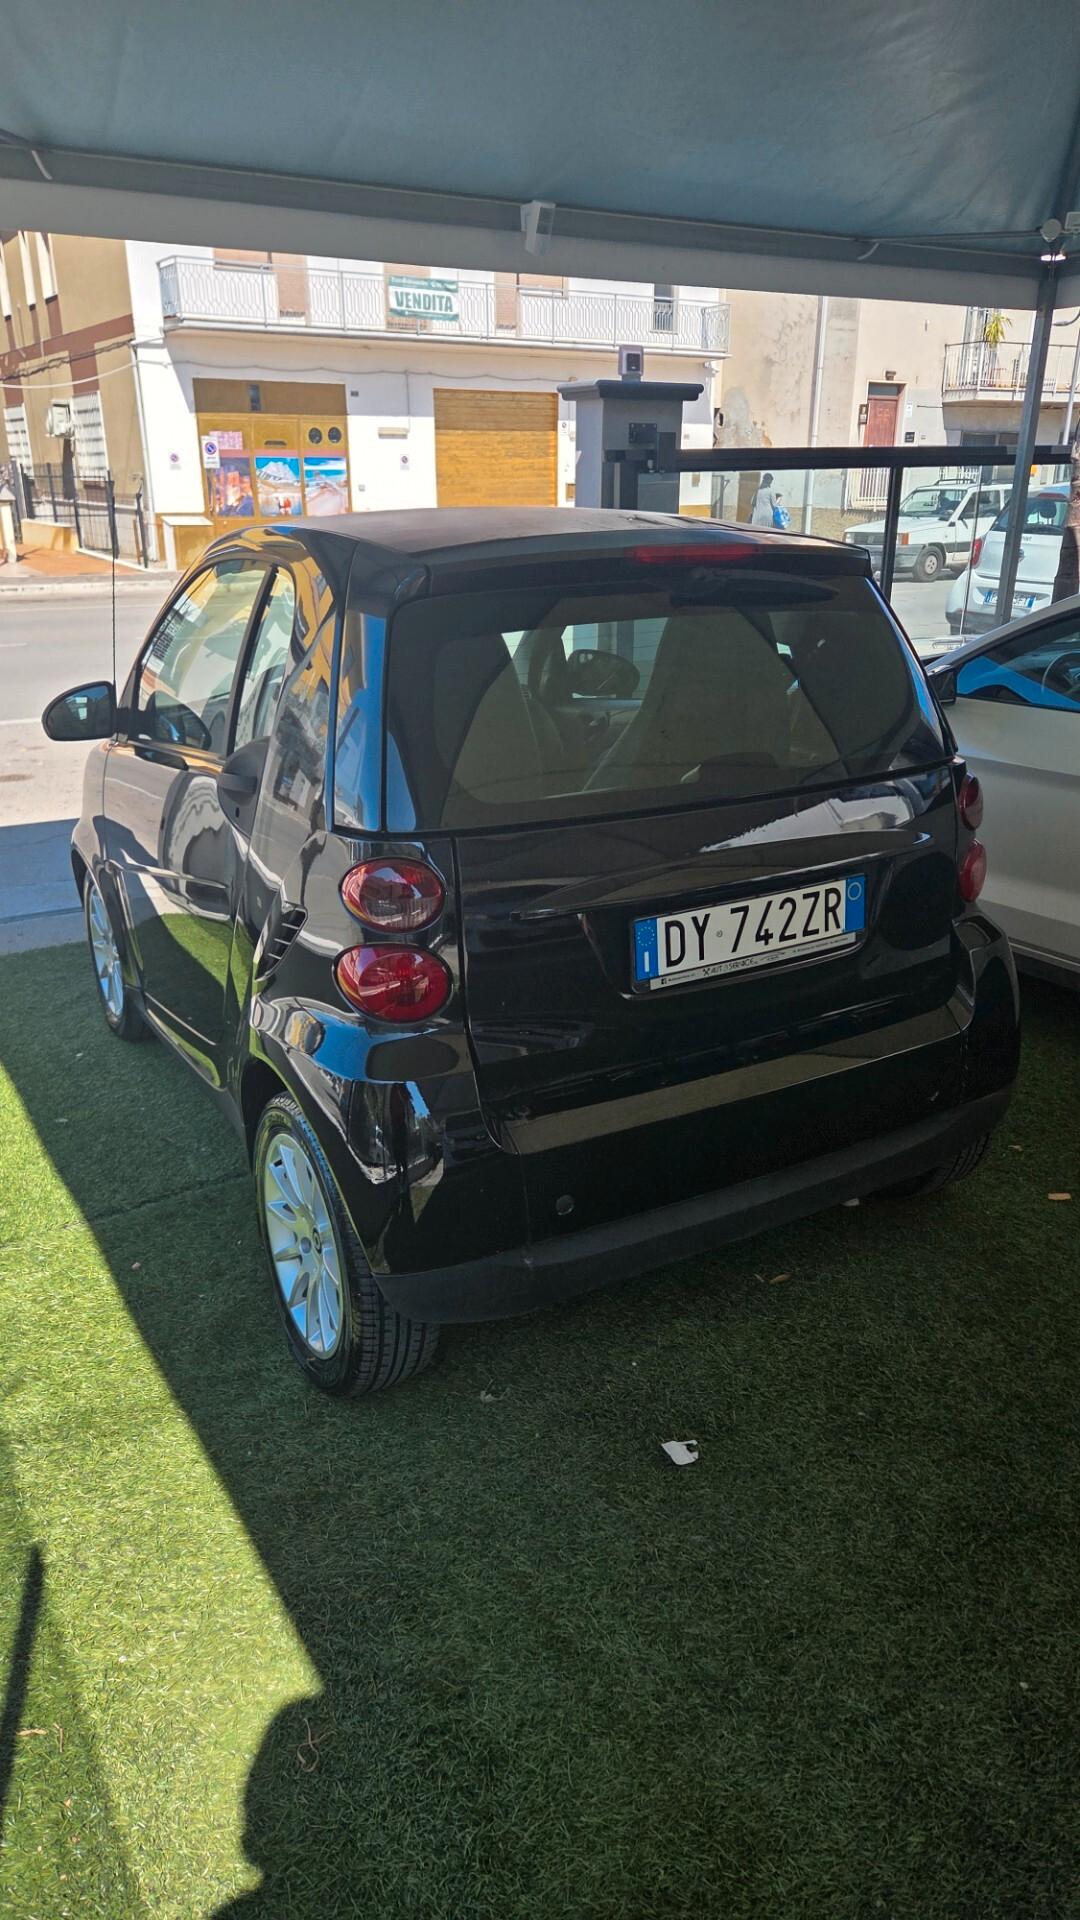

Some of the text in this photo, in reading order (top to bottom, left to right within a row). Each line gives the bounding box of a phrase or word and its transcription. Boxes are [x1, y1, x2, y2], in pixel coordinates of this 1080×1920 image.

[394, 290, 453, 313] VENDITA
[664, 887, 842, 968] DY 742ZR
